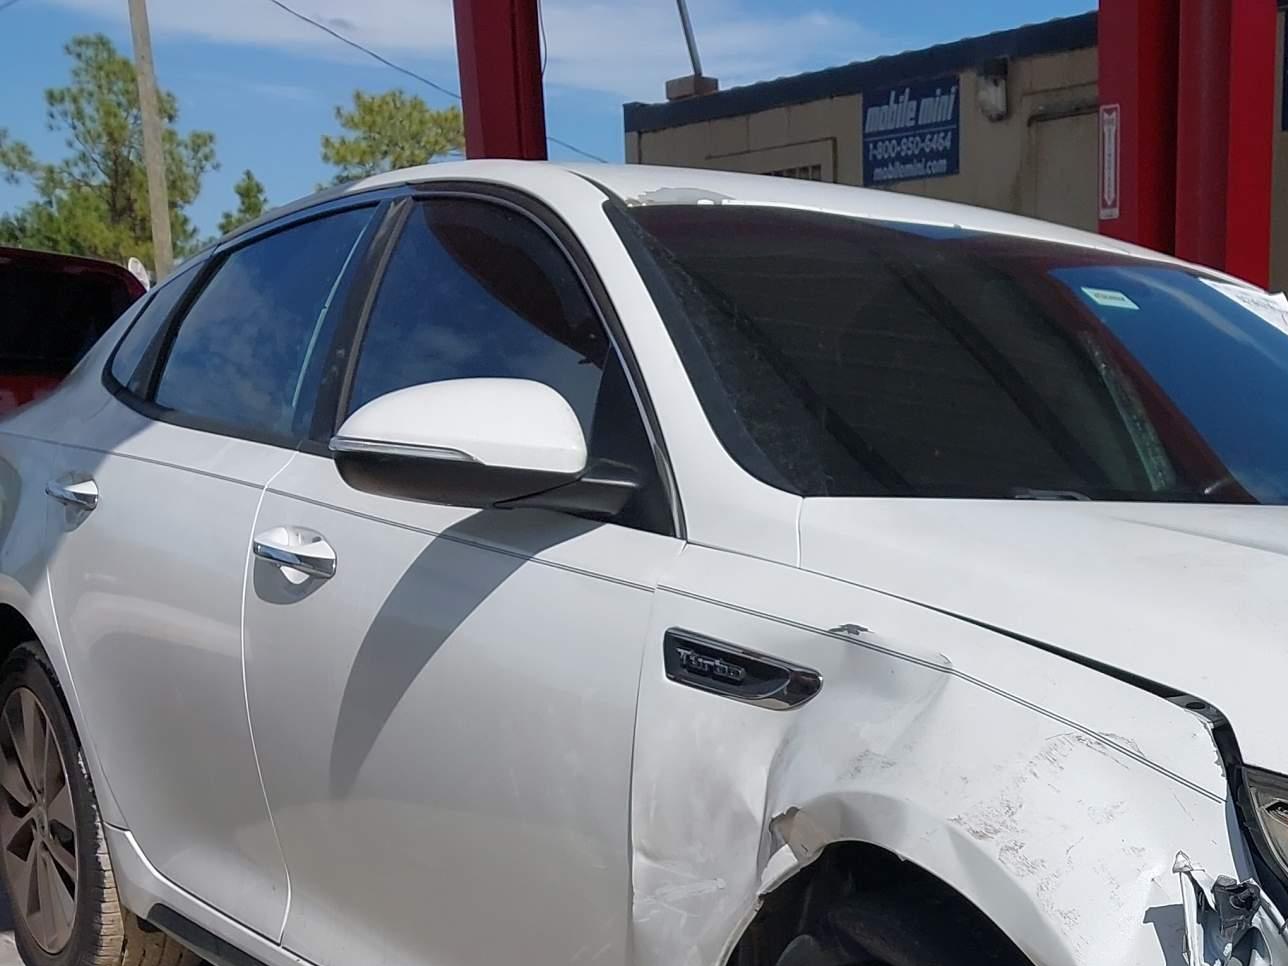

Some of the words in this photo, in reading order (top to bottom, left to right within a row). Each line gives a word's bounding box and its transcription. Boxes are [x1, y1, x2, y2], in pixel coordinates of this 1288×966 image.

[865, 87, 917, 133] mobile
[918, 85, 957, 125] mini
[869, 130, 952, 160] 1-800-950-6464
[873, 158, 947, 181] mobilemini.com
[676, 647, 746, 681] Turbo
